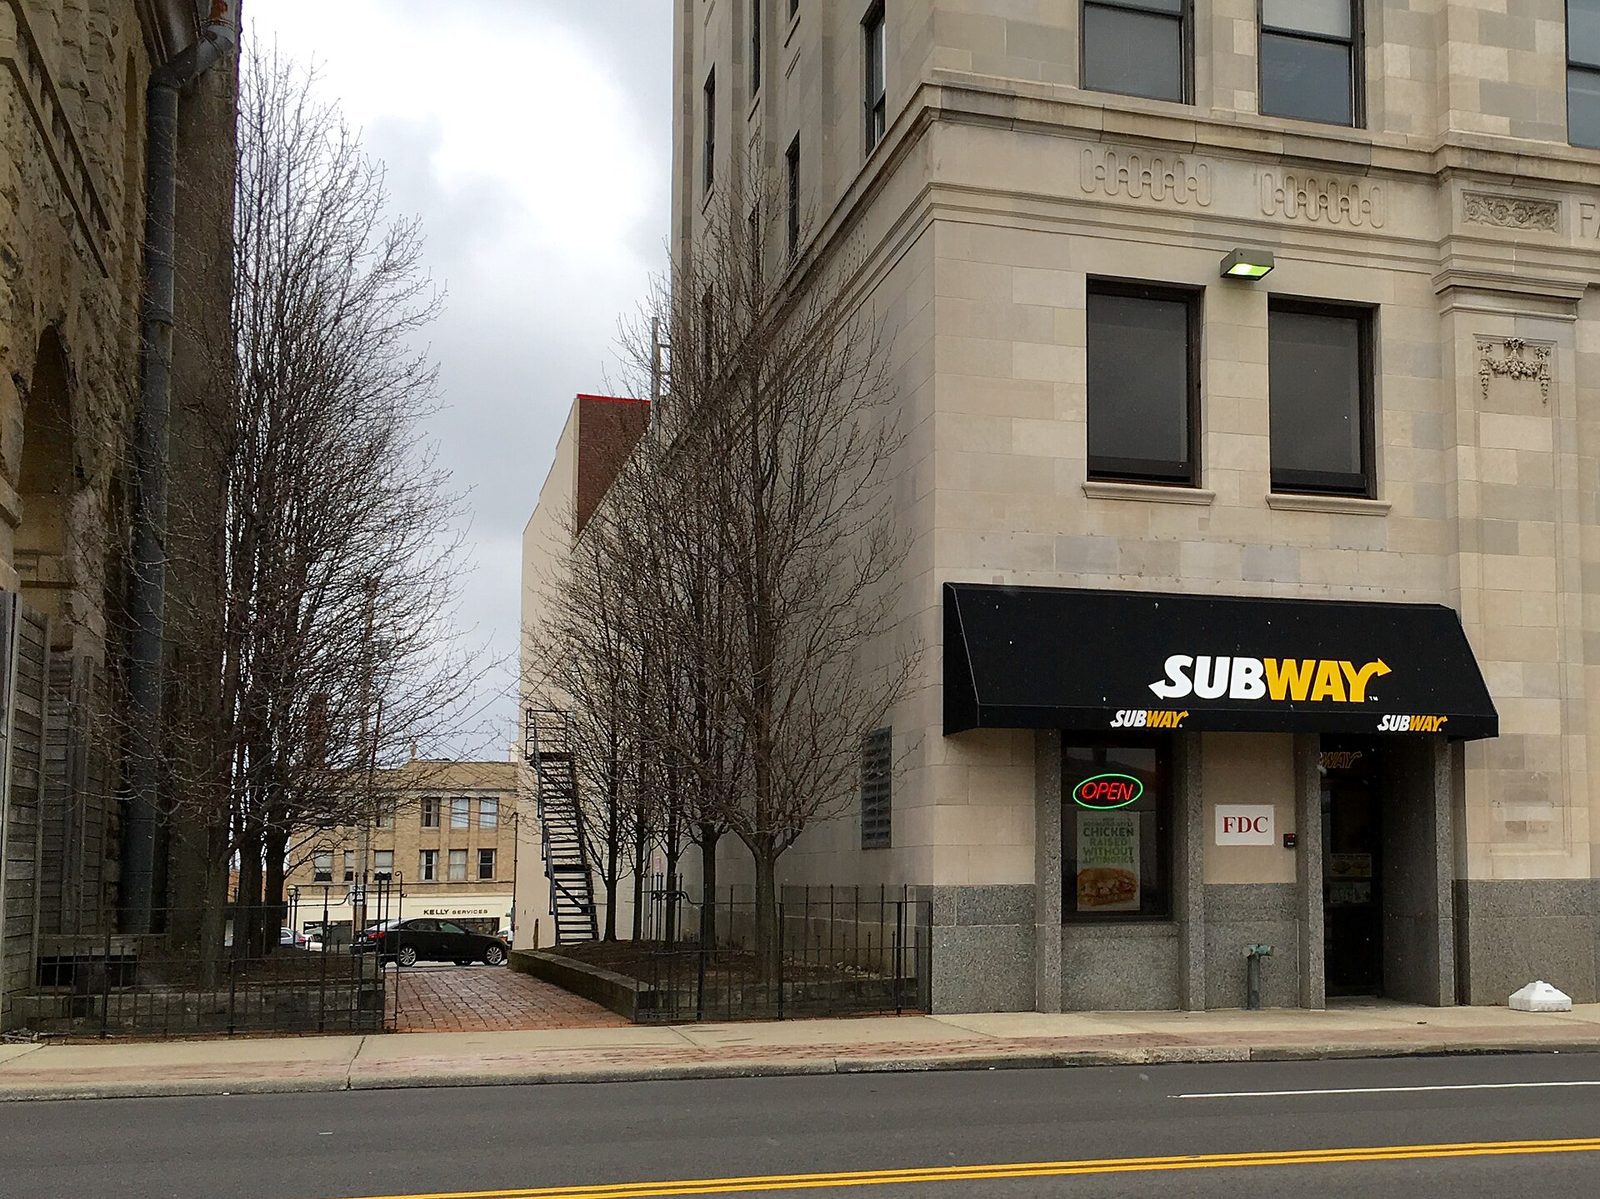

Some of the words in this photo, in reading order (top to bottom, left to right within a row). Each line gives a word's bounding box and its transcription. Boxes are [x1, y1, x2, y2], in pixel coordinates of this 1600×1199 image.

[1148, 654, 1393, 702] SUBWAY
[1109, 709, 1190, 728] SUBWAY
[1376, 714, 1448, 732] SUBWAY
[1320, 751, 1363, 769] WAY
[1081, 782, 1134, 801] OPEN
[1083, 827, 1134, 837] CHICKEN
[1222, 815, 1269, 834] FDC
[1089, 838, 1128, 846] RAISED
[1083, 847, 1134, 856] WITHOUT
